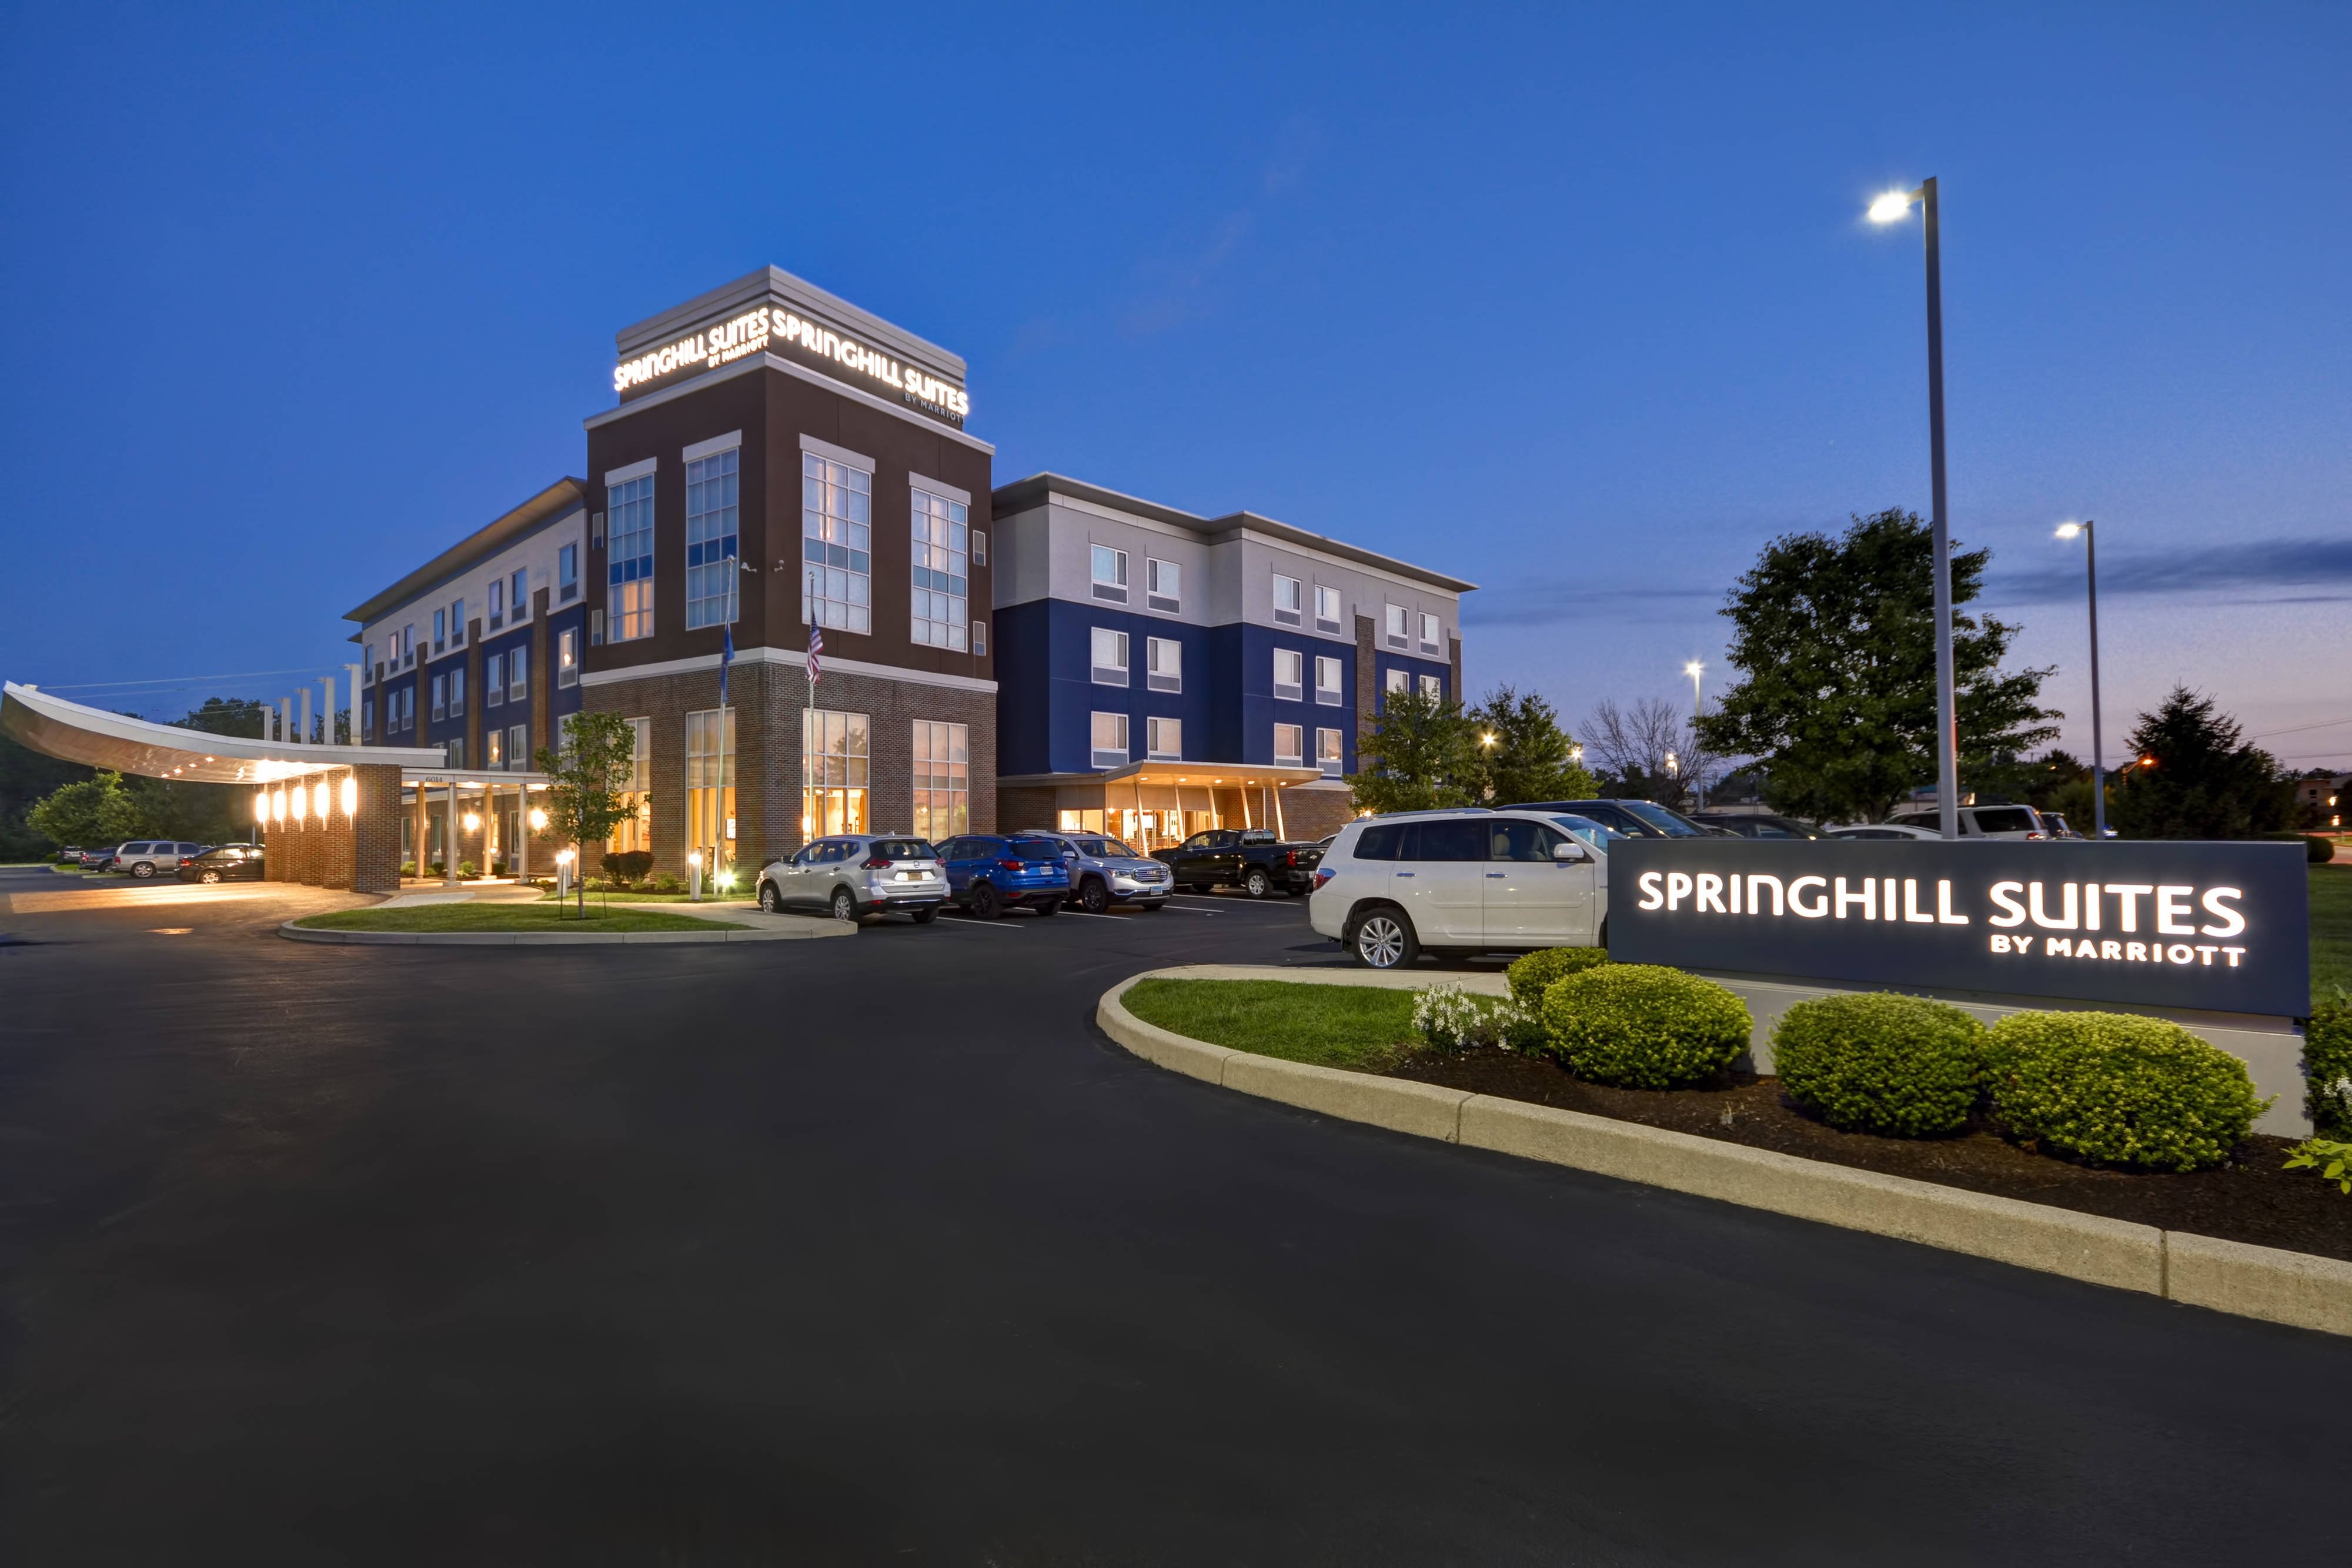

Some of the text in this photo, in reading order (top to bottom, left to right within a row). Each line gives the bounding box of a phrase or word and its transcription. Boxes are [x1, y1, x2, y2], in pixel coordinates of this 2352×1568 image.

[614, 307, 769, 392] SPRINGHILL SUITES
[708, 334, 769, 368] BY MARRIOTT
[771, 309, 969, 416] SPRINGHILL SUITES
[906, 393, 917, 404] BY
[1638, 871, 2246, 938] SPRINGHILL SUITES
[1990, 934, 2247, 968] BY MARRIOTT
